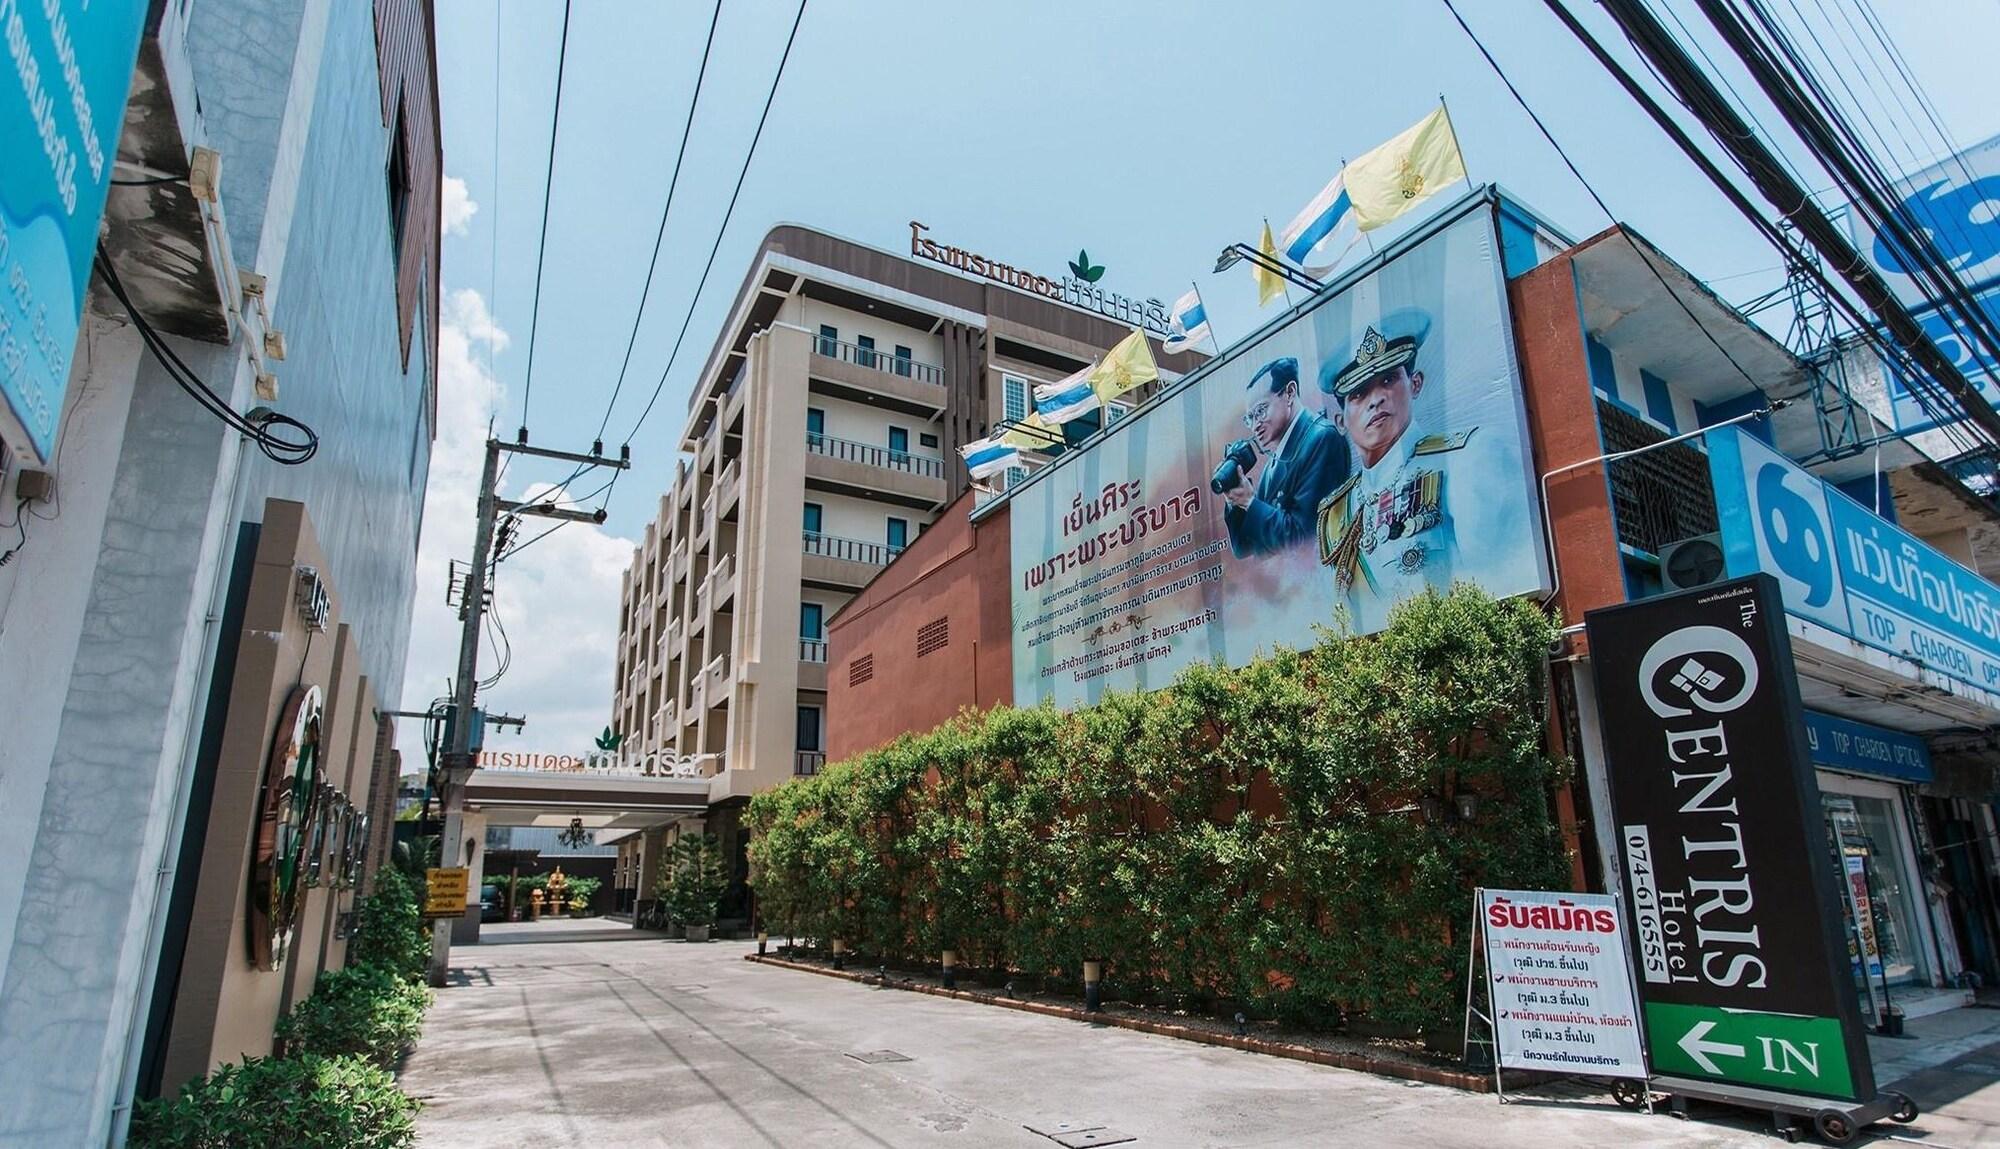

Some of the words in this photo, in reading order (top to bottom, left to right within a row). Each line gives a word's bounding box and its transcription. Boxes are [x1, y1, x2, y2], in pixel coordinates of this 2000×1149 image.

[1063, 479, 1140, 537] เย็นศิระ
[1024, 487, 1200, 591] เพราะพระบริบาล
[1740, 599, 1757, 628] The
[1862, 607, 1896, 645] TOP
[1910, 630, 1973, 677] CHAROEN
[1832, 731, 1850, 755] TOP
[1638, 625, 1767, 989] CENTRIS
[1488, 896, 1616, 934] รับสมัคร
[1629, 836, 1664, 972] 074-616555
[1504, 938, 1600, 957] พนักงานต้อนรับหญิง
[1659, 889, 1699, 984] Hotel
[1755, 1036, 1819, 1078] IN
